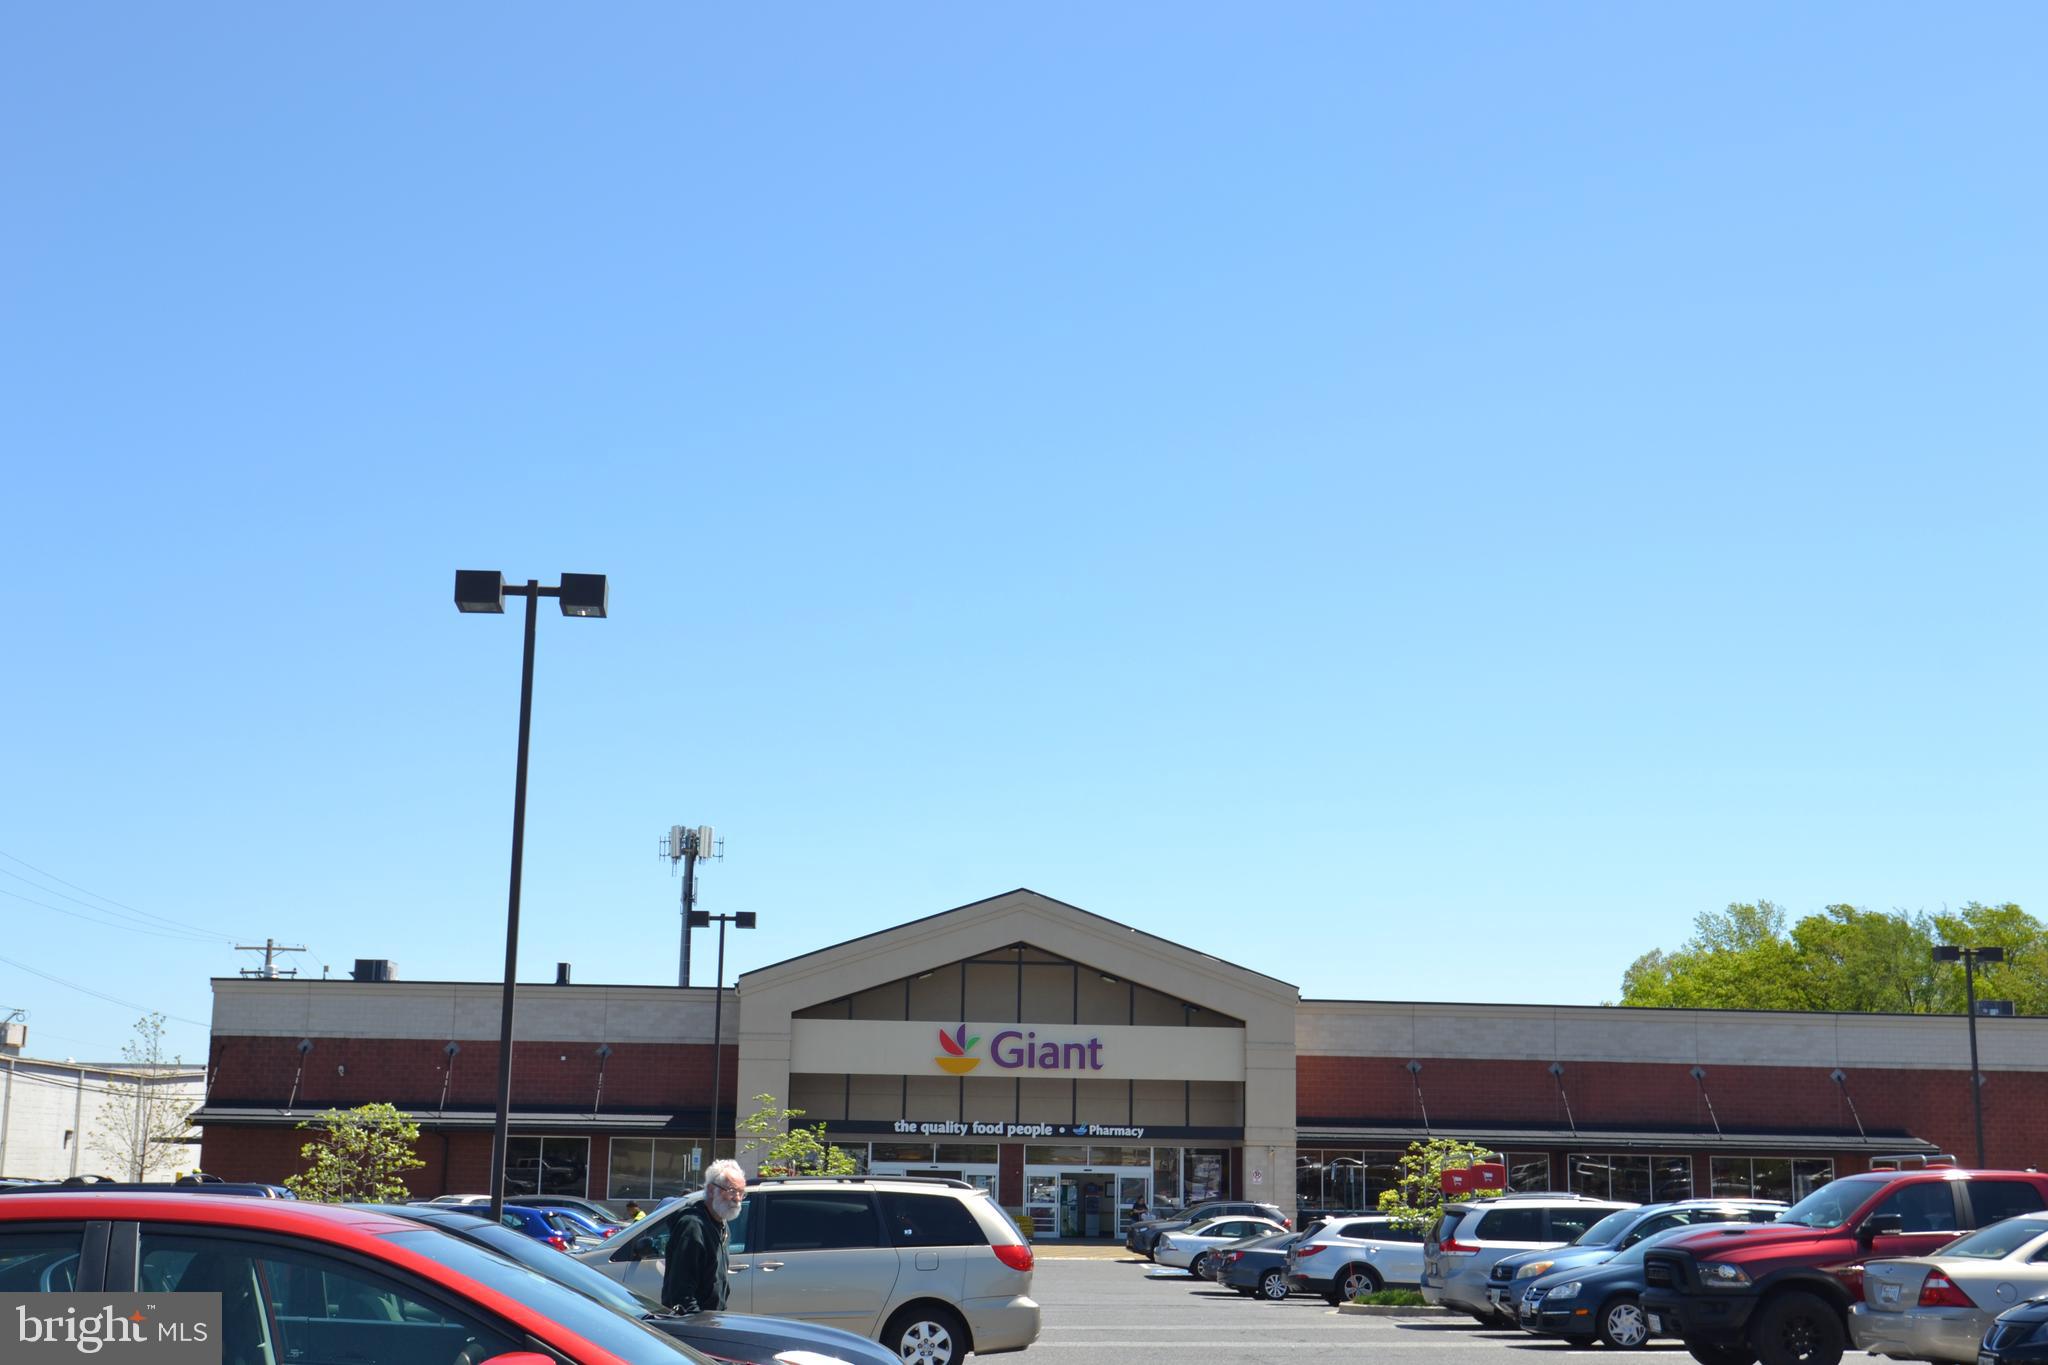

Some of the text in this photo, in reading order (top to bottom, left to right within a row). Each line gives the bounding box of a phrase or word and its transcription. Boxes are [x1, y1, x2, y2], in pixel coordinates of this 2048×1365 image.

[991, 1031, 1104, 1070] Giant
[894, 1120, 1144, 1139] the quality food people Pharmacy
